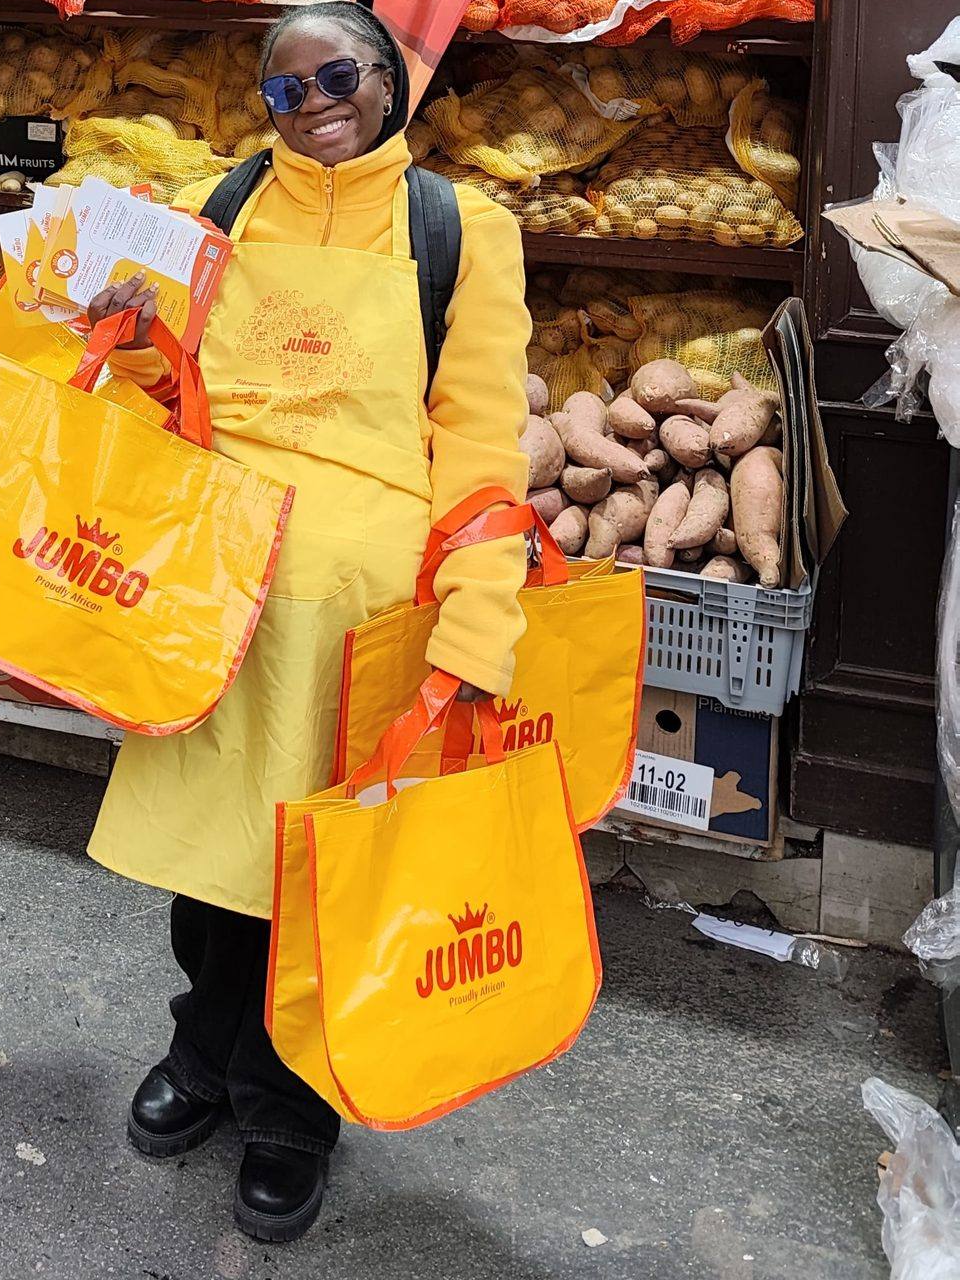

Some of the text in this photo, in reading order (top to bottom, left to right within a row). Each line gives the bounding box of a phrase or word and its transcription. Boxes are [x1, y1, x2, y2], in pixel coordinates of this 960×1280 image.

[19, 158, 56, 169] FRUITS
[282, 337, 332, 356] JUMBO
[12, 526, 150, 608] JUMBO
[34, 575, 103, 613] Proudly African
[638, 764, 687, 793] 11-02
[416, 920, 523, 999] JUMBO
[449, 980, 506, 1008] Proudly African
